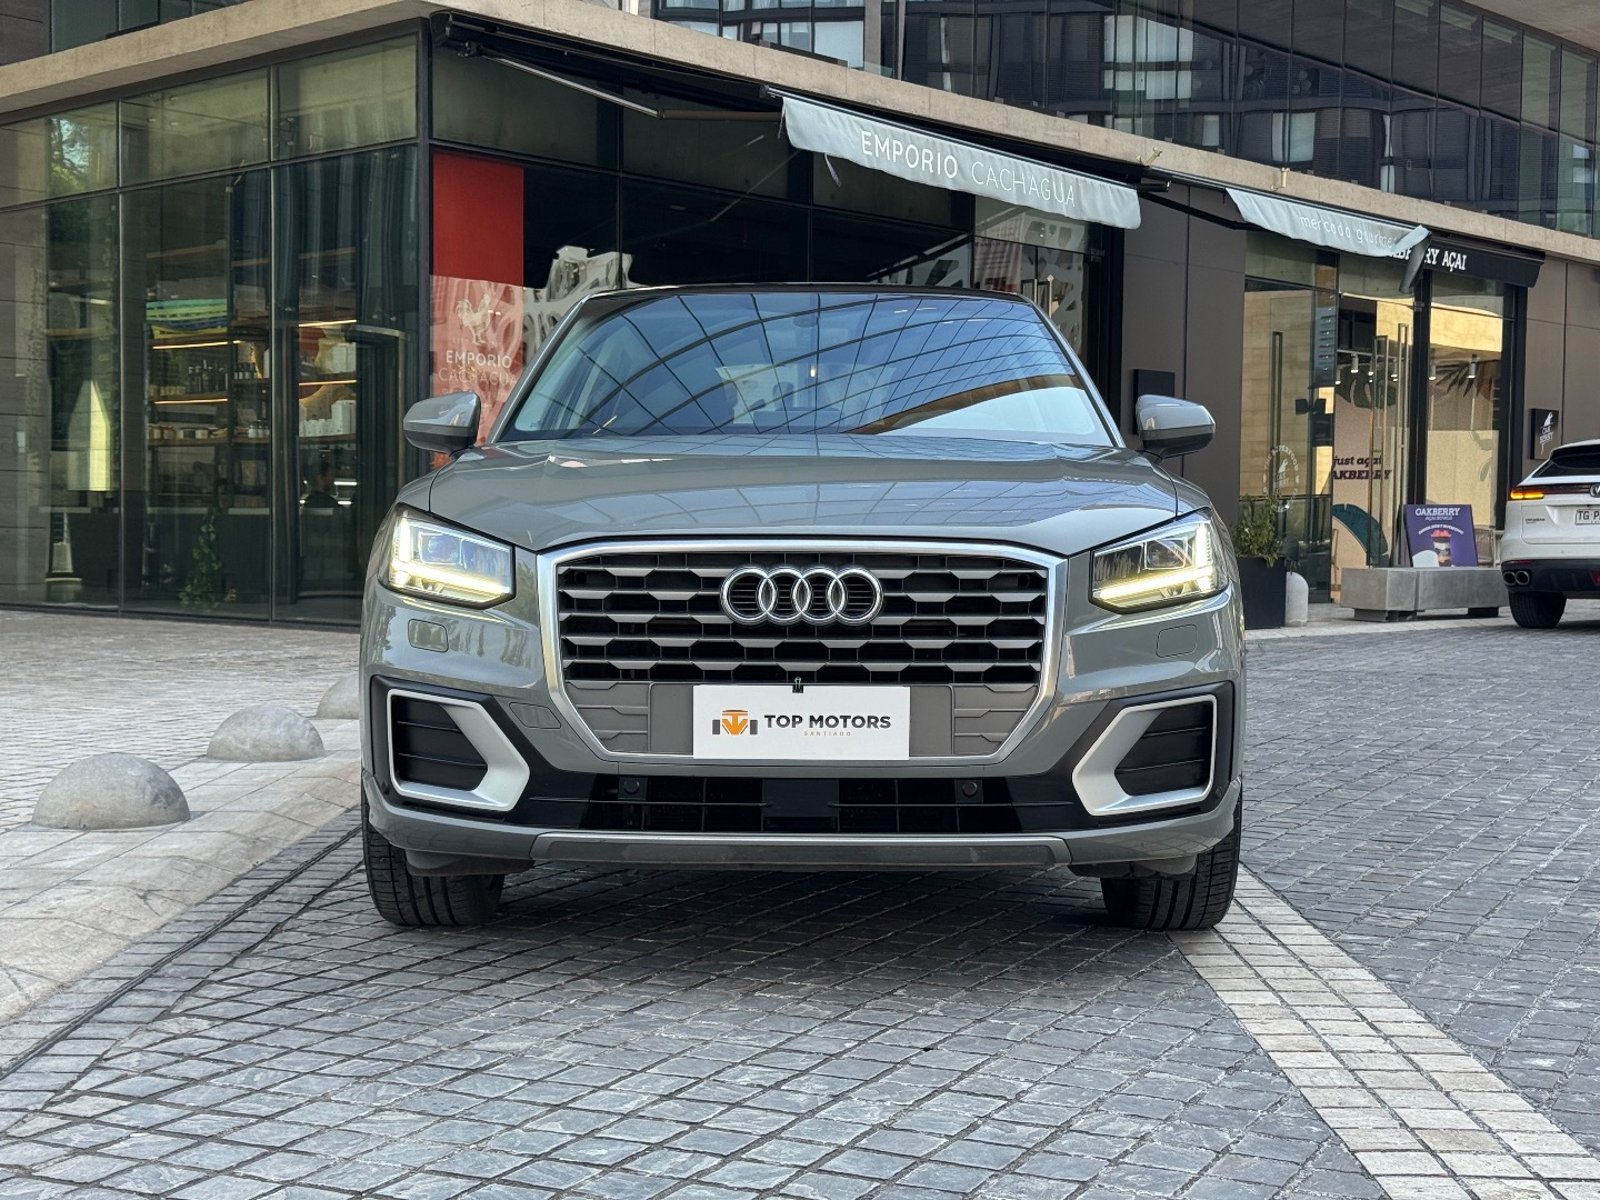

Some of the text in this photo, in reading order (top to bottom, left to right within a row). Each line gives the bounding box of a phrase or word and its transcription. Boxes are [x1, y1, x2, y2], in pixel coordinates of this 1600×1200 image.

[861, 130, 1075, 208] EMPORIO CACHAGUA
[1300, 216, 1398, 249] mercado gourme
[1442, 250, 1467, 272] AÇAI
[446, 350, 512, 369] EMPORIO
[1415, 507, 1460, 516] OAKBERRY
[764, 714, 891, 729] TOP MOTORS
